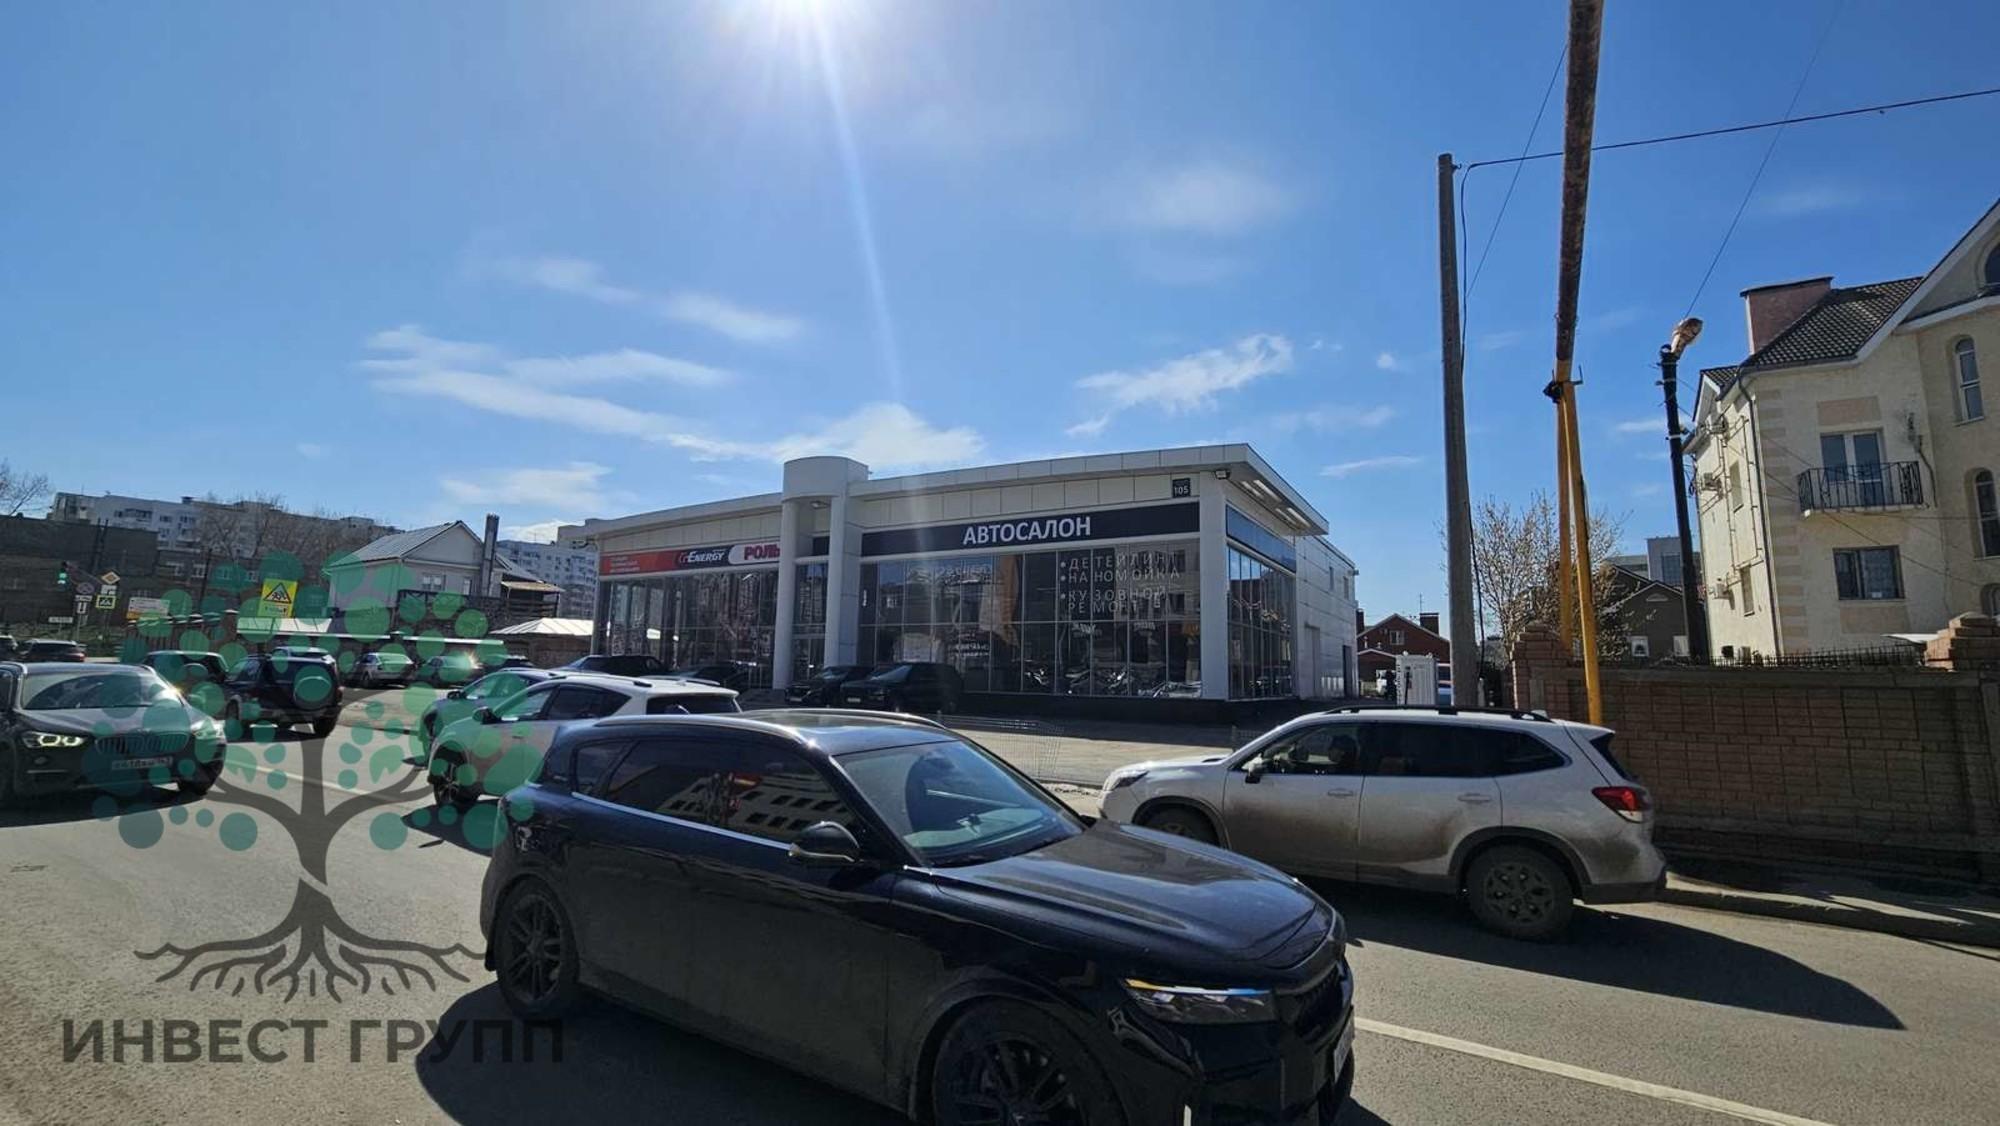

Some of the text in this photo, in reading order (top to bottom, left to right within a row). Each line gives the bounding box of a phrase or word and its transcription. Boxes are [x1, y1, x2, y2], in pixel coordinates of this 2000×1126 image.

[1174, 485, 1189, 497] 105
[963, 516, 1091, 545] АВТОСАЛОН
[1068, 599, 1138, 614] РЕМОНТ
